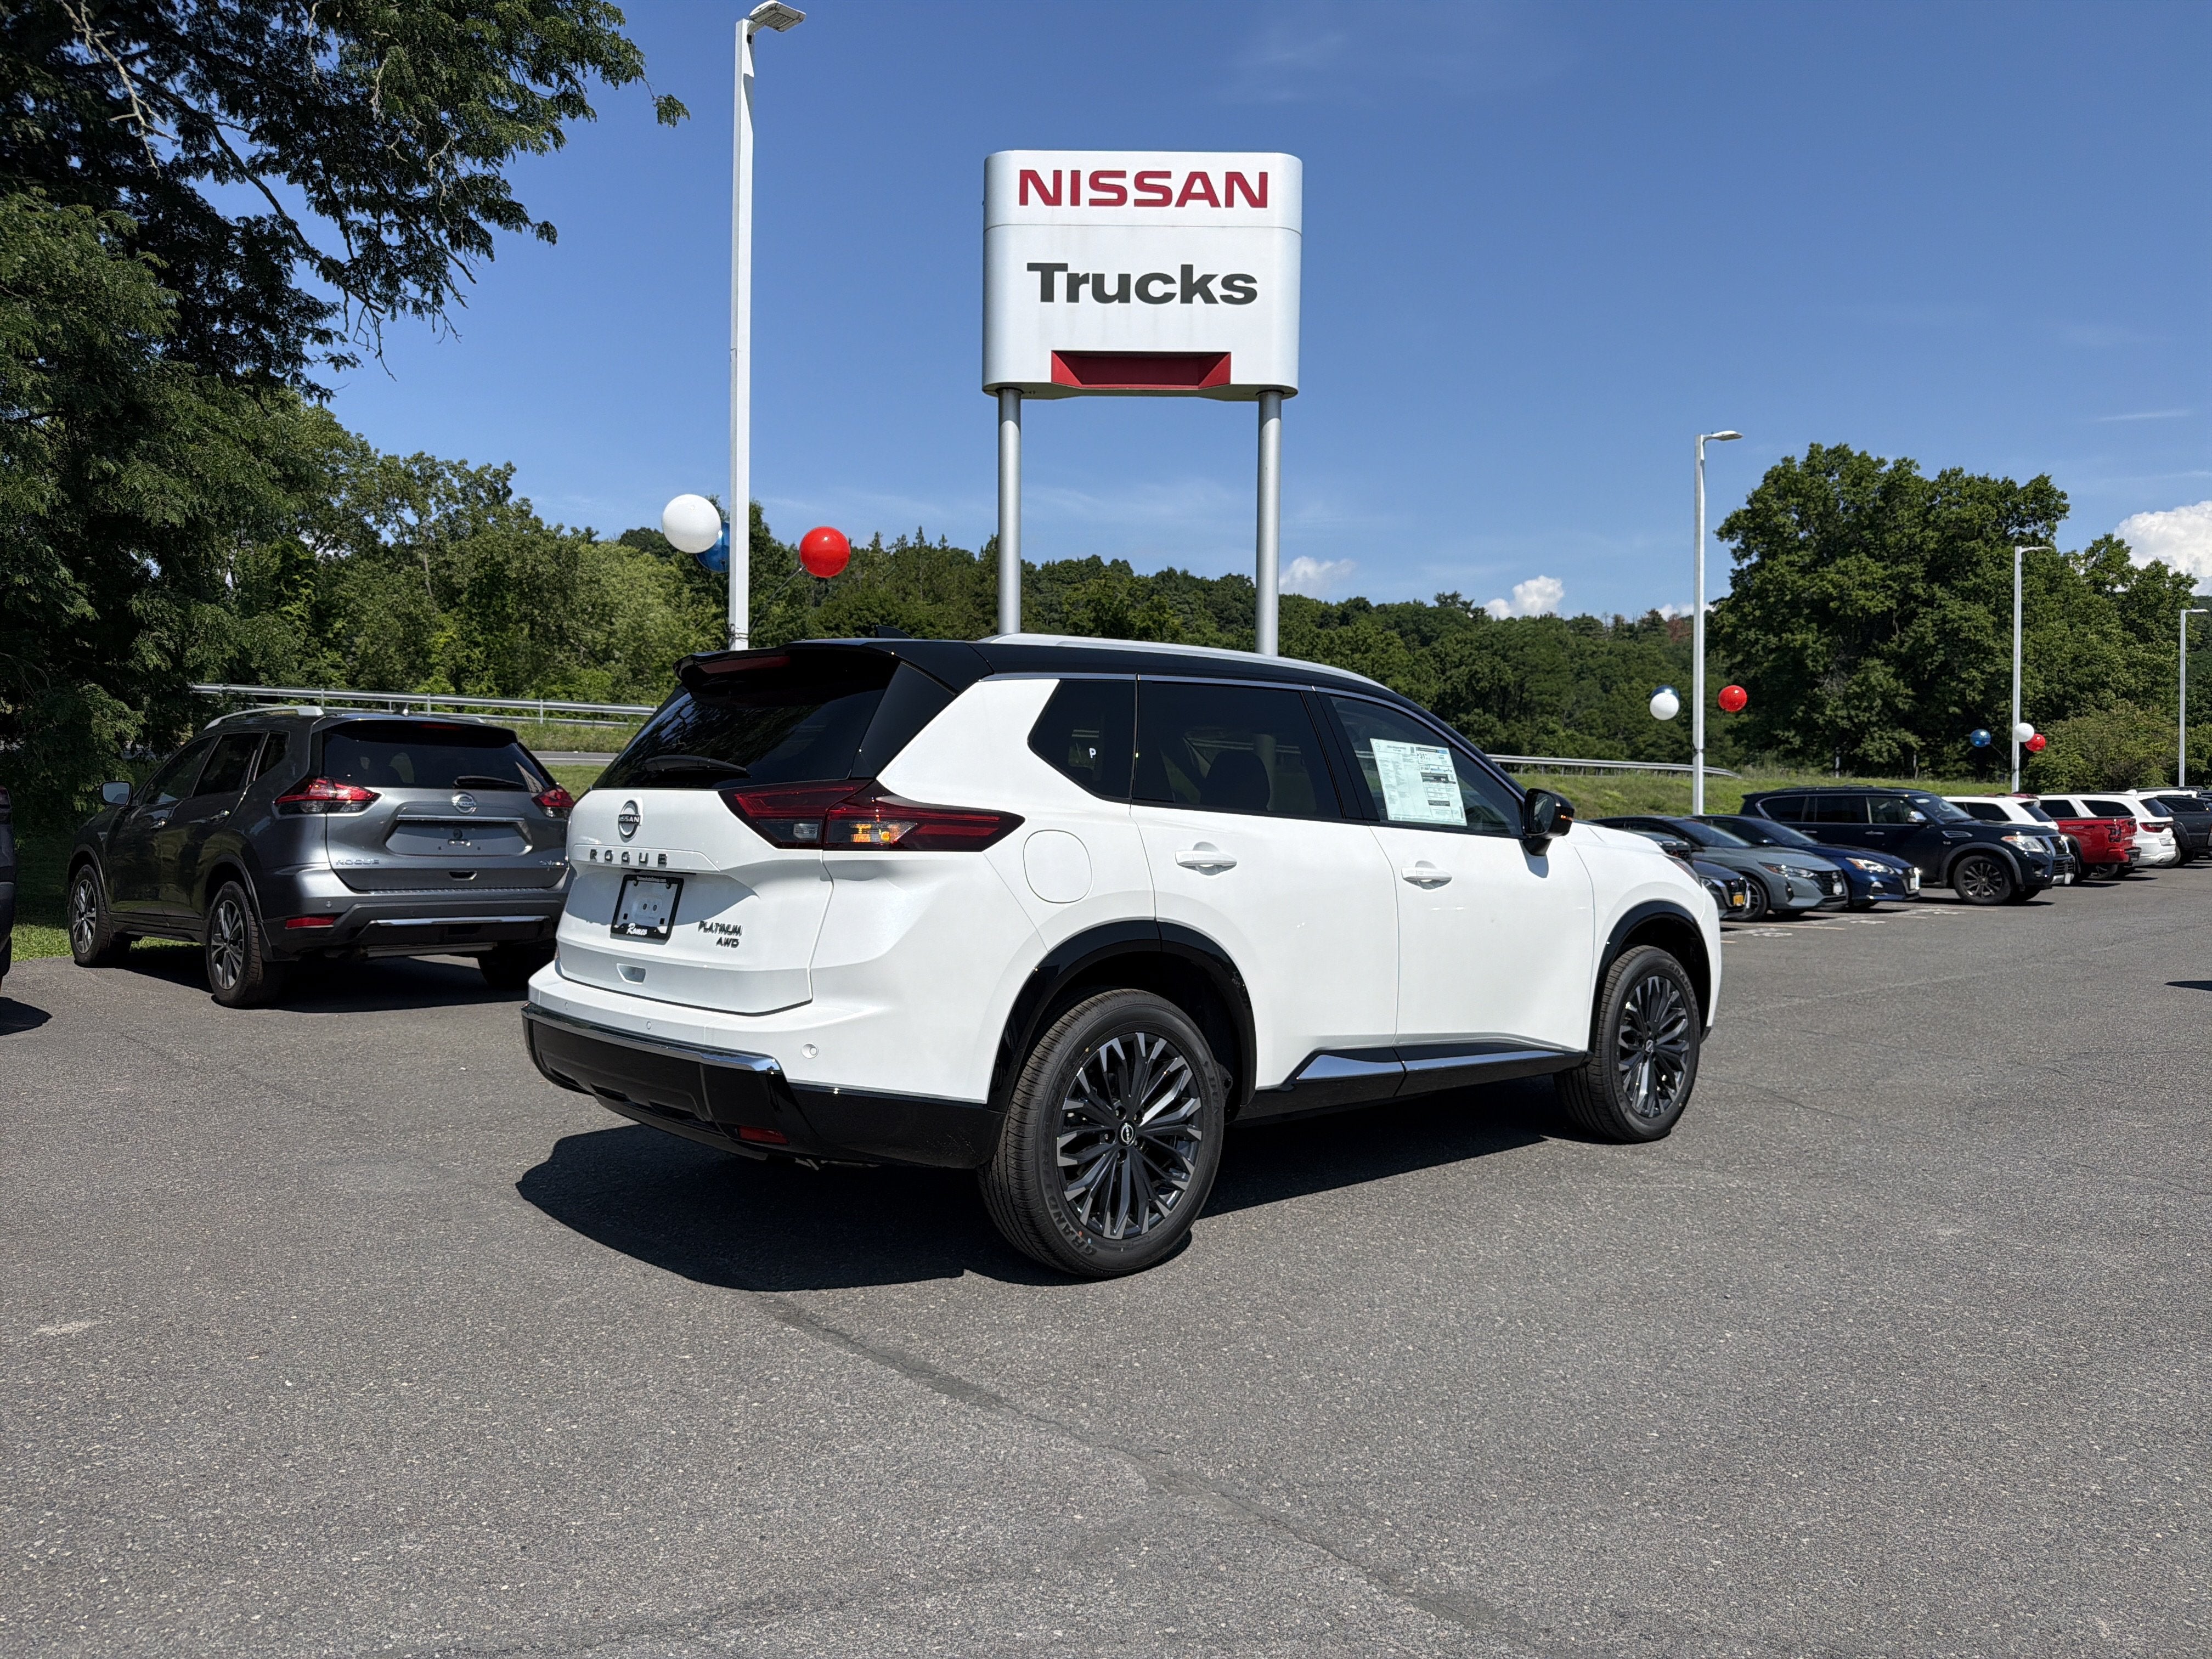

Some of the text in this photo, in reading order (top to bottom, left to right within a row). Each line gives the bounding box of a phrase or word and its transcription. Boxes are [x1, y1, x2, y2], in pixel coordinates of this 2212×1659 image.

[1018, 170, 1268, 208] NISSAN
[1026, 262, 1258, 306] Trucks
[1088, 747, 1097, 759] P
[590, 849, 668, 865] ROGUE
[698, 920, 743, 936] PLATINUM
[715, 936, 740, 948] AWD
